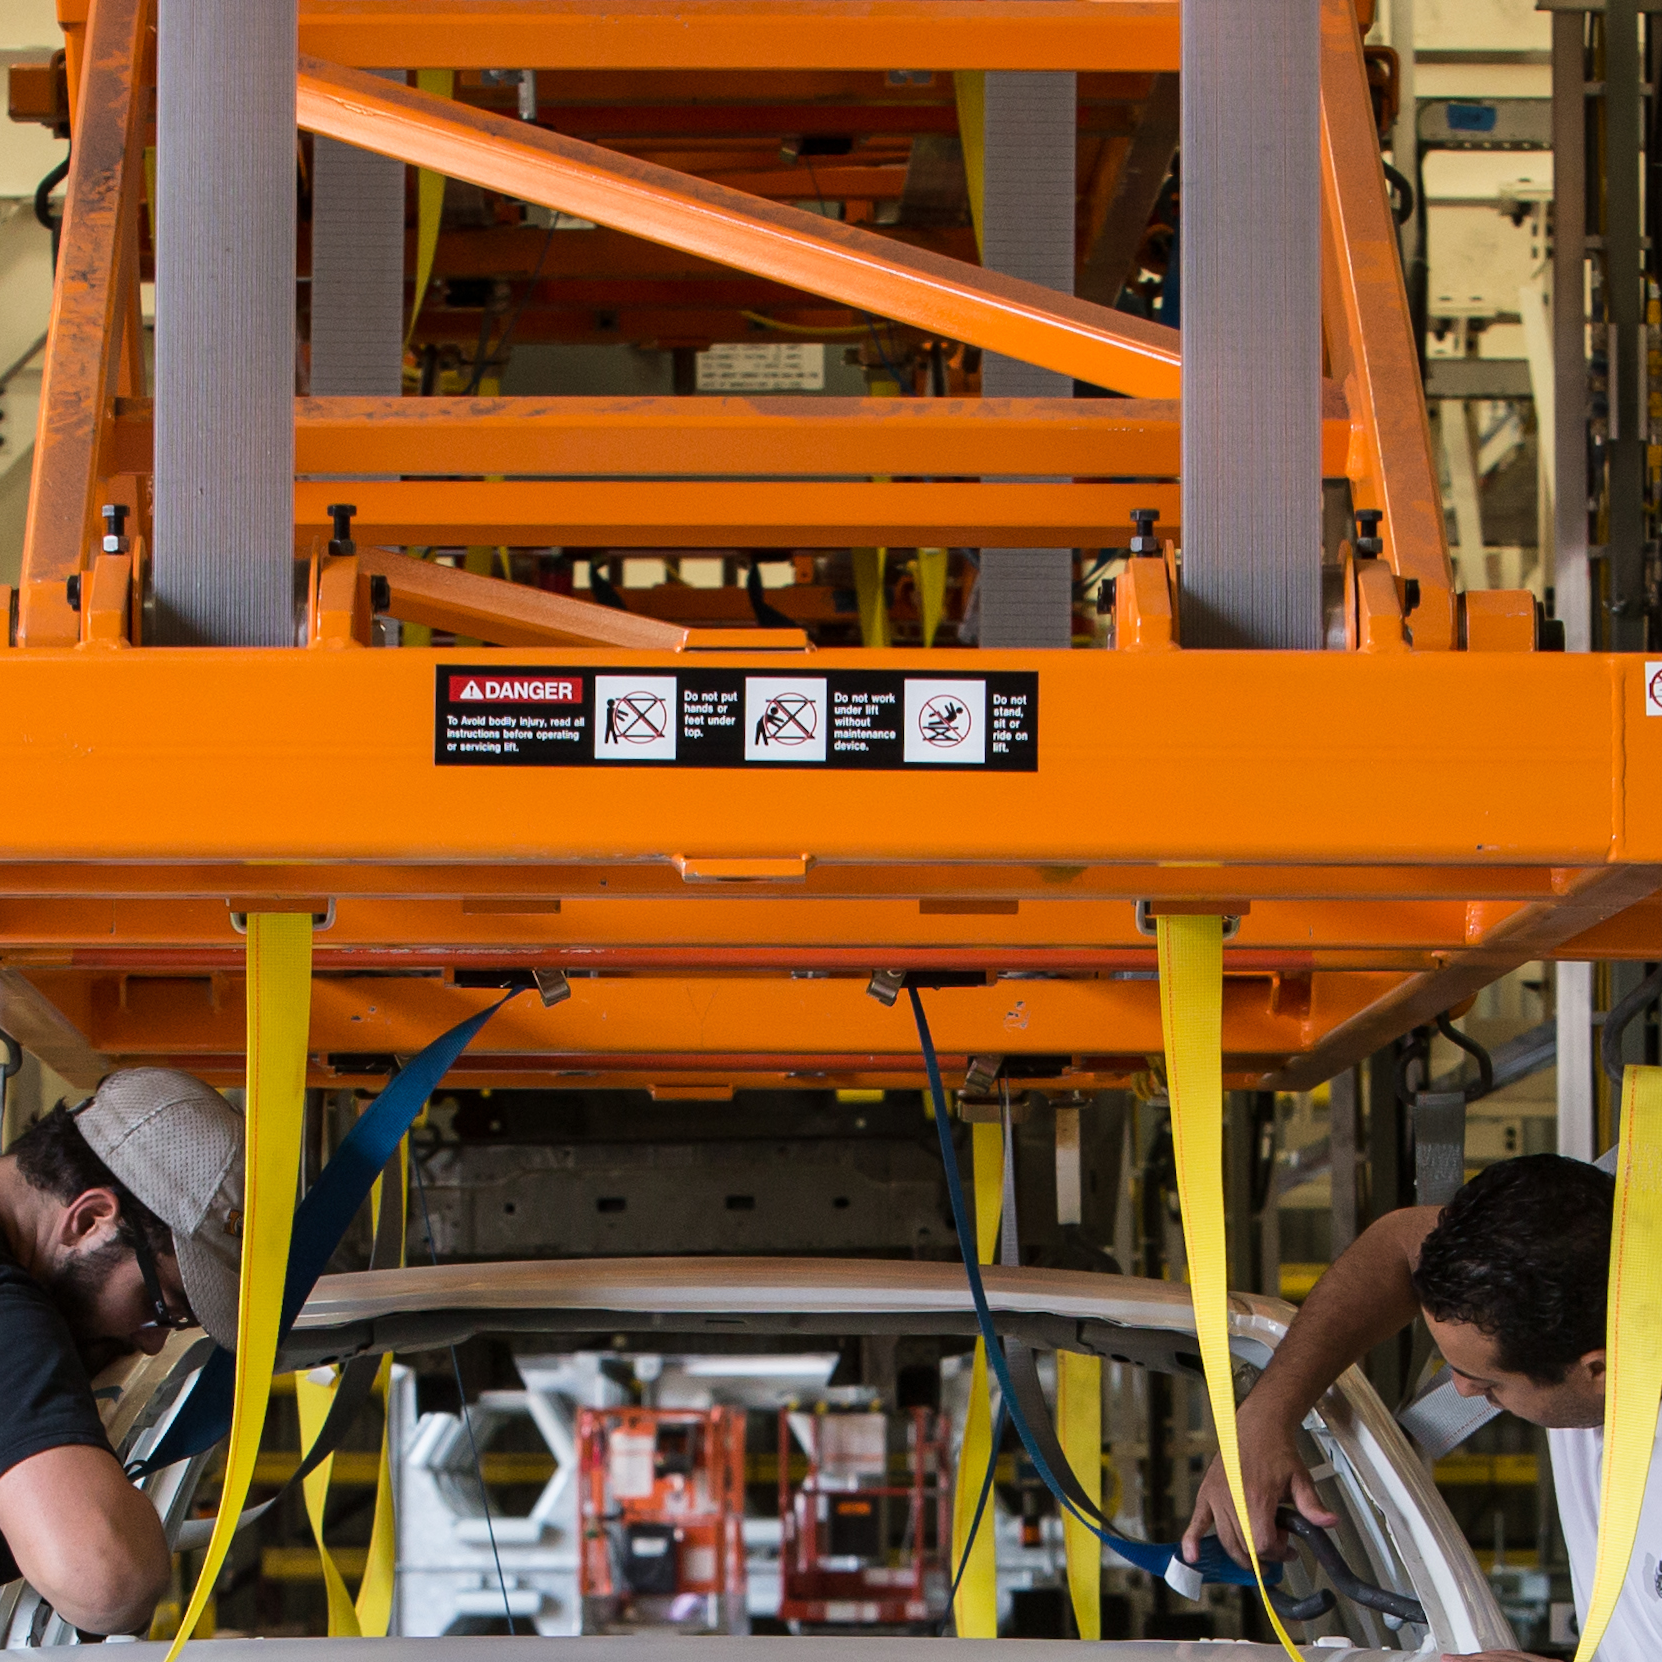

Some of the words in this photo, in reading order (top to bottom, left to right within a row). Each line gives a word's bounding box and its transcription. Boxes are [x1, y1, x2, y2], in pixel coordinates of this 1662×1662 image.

[485, 681, 573, 700] DANGER
[684, 690, 698, 702] Do
[701, 691, 718, 702] not
[721, 691, 738, 704] put
[834, 692, 849, 703] Do
[851, 693, 869, 703] not
[871, 693, 895, 704] work
[992, 693, 1007, 705] Do
[1010, 694, 1027, 705] not
[684, 703, 714, 714] hands
[717, 705, 728, 714] or
[834, 704, 863, 715] under
[865, 704, 879, 715] lift
[993, 706, 1024, 718] stand,
[447, 715, 458, 726] To
[461, 716, 486, 727] Avoid
[489, 716, 516, 728] bodily
[550, 717, 570, 727] read
[574, 717, 585, 727] all
[684, 714, 705, 725] feet
[707, 715, 736, 726] under
[834, 716, 871, 727] without
[993, 718, 1006, 729] sit
[1009, 720, 1020, 729] or
[447, 729, 500, 739] instructions
[503, 729, 533, 739] before
[536, 730, 580, 742] operating
[684, 727, 704, 739] top.
[834, 728, 896, 739] maintenance
[992, 730, 1012, 741] ride
[1015, 732, 1028, 741] on
[447, 743, 457, 751] or
[460, 742, 501, 754] servicing
[504, 742, 519, 752] lift.
[834, 740, 869, 751] device.
[992, 742, 1009, 753] lift.
